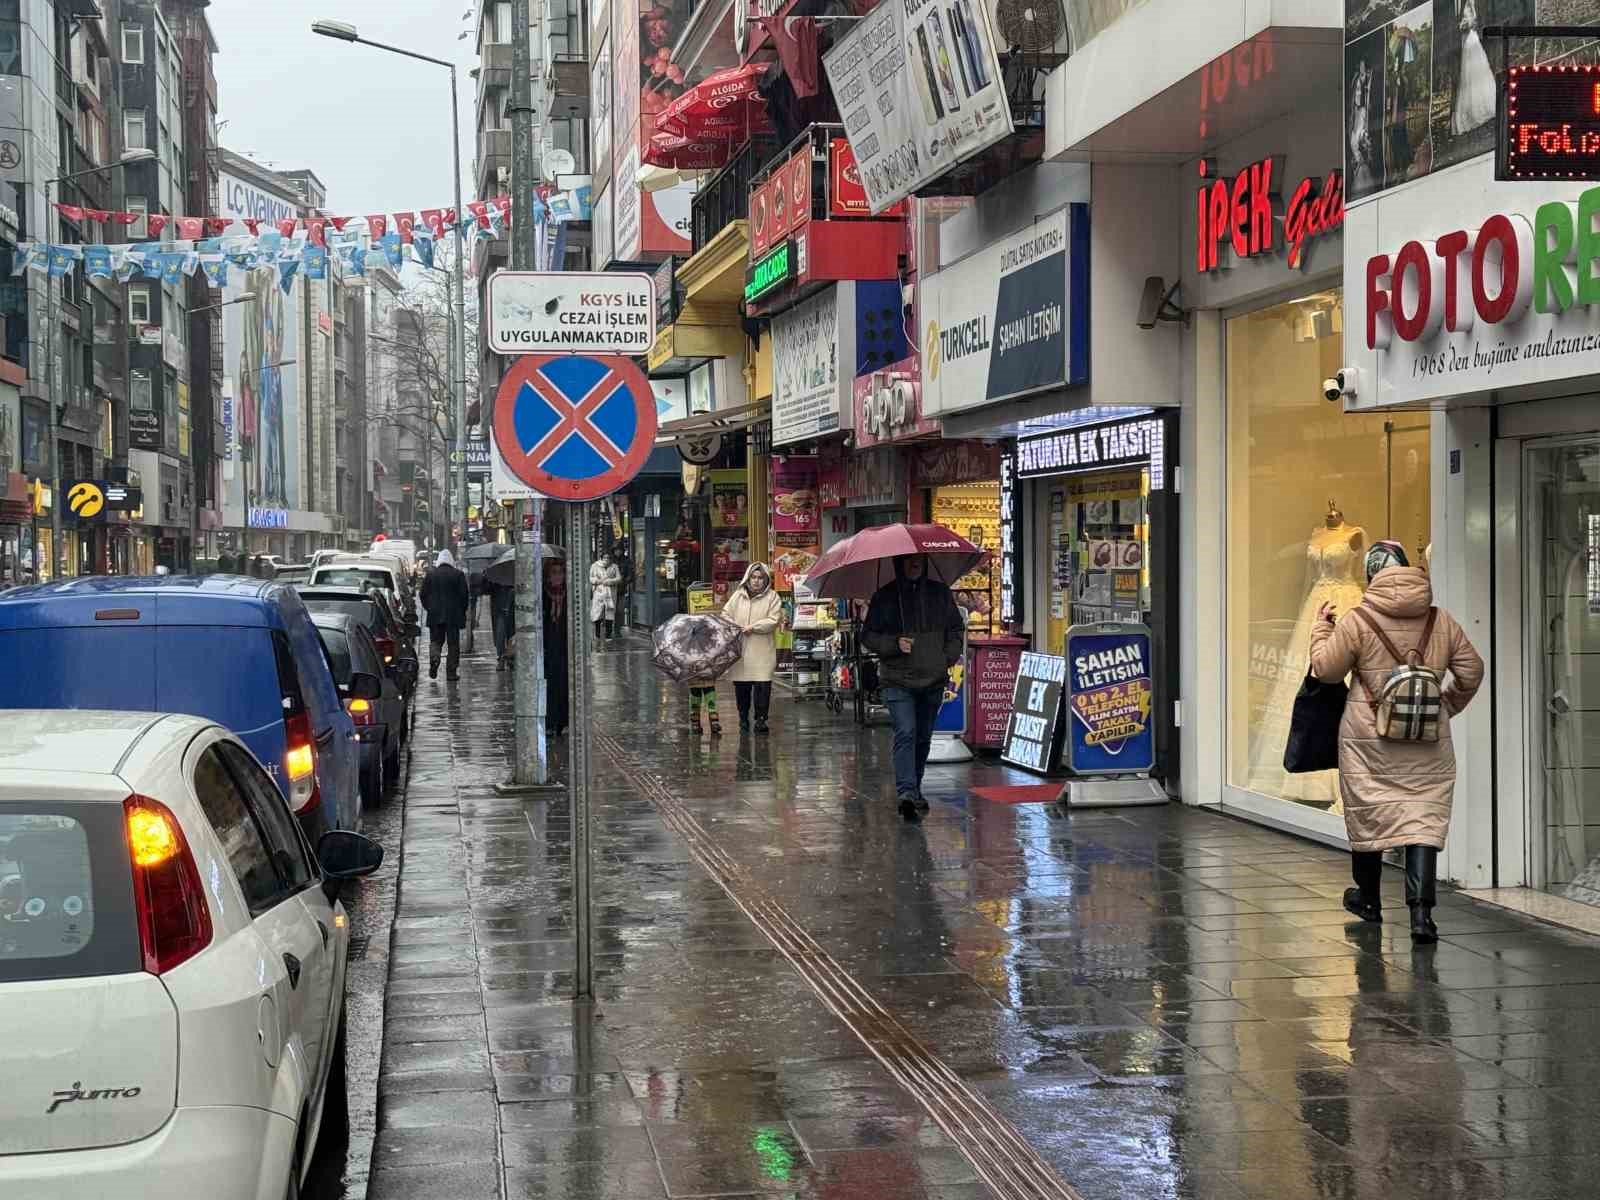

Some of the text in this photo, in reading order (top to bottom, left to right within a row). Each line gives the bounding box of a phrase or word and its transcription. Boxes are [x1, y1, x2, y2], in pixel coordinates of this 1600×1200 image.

[1367, 214, 1520, 350] FOTO
[580, 291, 648, 306] KGYS İLE
[605, 310, 647, 328] İŞLEM
[999, 301, 1061, 357] ŞAHAN İLETİŞİM
[500, 330, 649, 344] UYGULANMAKTADIR
[940, 313, 990, 364] TURKCELL
[1018, 433, 1079, 471] FATURAYA
[1080, 429, 1099, 463] EK
[1100, 419, 1151, 460] TAKSİT
[1075, 643, 1142, 674] ŞAHAN
[1079, 662, 1145, 689] İLETİŞİM
[1027, 681, 1049, 712] EK
[1080, 695, 1140, 716] TELEFONU
[1092, 692, 1109, 705] ve
[1128, 681, 1145, 696] EL
[1090, 724, 1136, 742] YAPILIR
[1096, 715, 1131, 730] TAKAS
